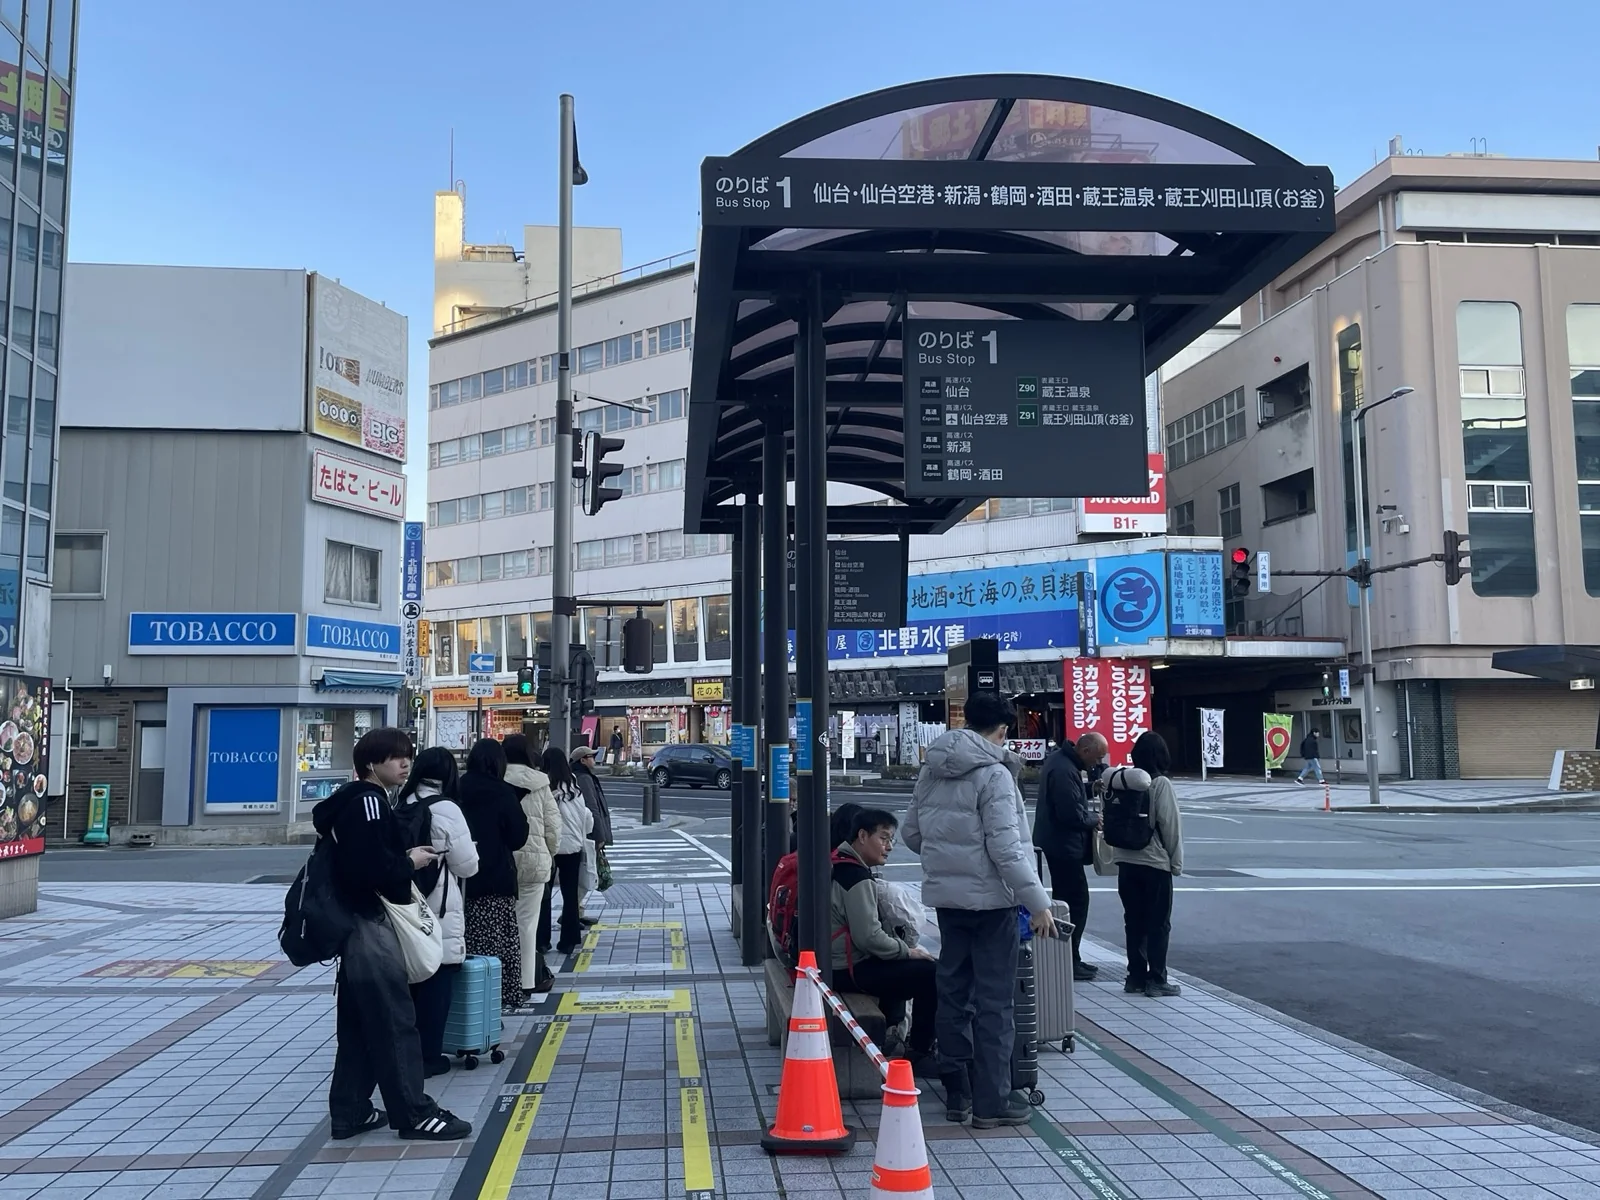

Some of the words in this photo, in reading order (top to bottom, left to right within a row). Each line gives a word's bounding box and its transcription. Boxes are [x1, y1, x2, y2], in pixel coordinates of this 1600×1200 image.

[715, 176, 769, 194] のりば
[776, 176, 791, 208] 1
[716, 197, 738, 208] Bus
[743, 197, 770, 209] Stop
[918, 331, 974, 349] のりば
[981, 330, 998, 364] 1
[918, 353, 942, 364] Bus
[946, 353, 975, 366] Stop
[945, 386, 970, 398] 仙台
[1019, 384, 1036, 392] Z90
[1042, 386, 1091, 398] 蔵王温泉
[960, 413, 1009, 426] 仙台空港
[1019, 411, 1036, 420] Z91
[1042, 413, 1134, 426] 蔵王刈田山頂(お釜)
[369, 420, 399, 443] BIG
[946, 441, 971, 453] 新潟
[947, 468, 1003, 481] 鶴岡・酒田
[319, 464, 401, 506] たばこ・ビール
[1113, 517, 1138, 529] B1F
[1260, 555, 1268, 588] バス専用
[1186, 557, 1196, 600] そして山形の
[150, 621, 277, 642] TOBACCO
[321, 624, 389, 650] TOBACCO
[696, 686, 721, 696] 花の木
[1073, 666, 1084, 728] JOYSOUND
[1084, 665, 1100, 729] カラオケ
[1111, 666, 1127, 742] JOYSOUND
[1207, 713, 1220, 764] どんどん焼き
[210, 751, 278, 763] TOBACCO
